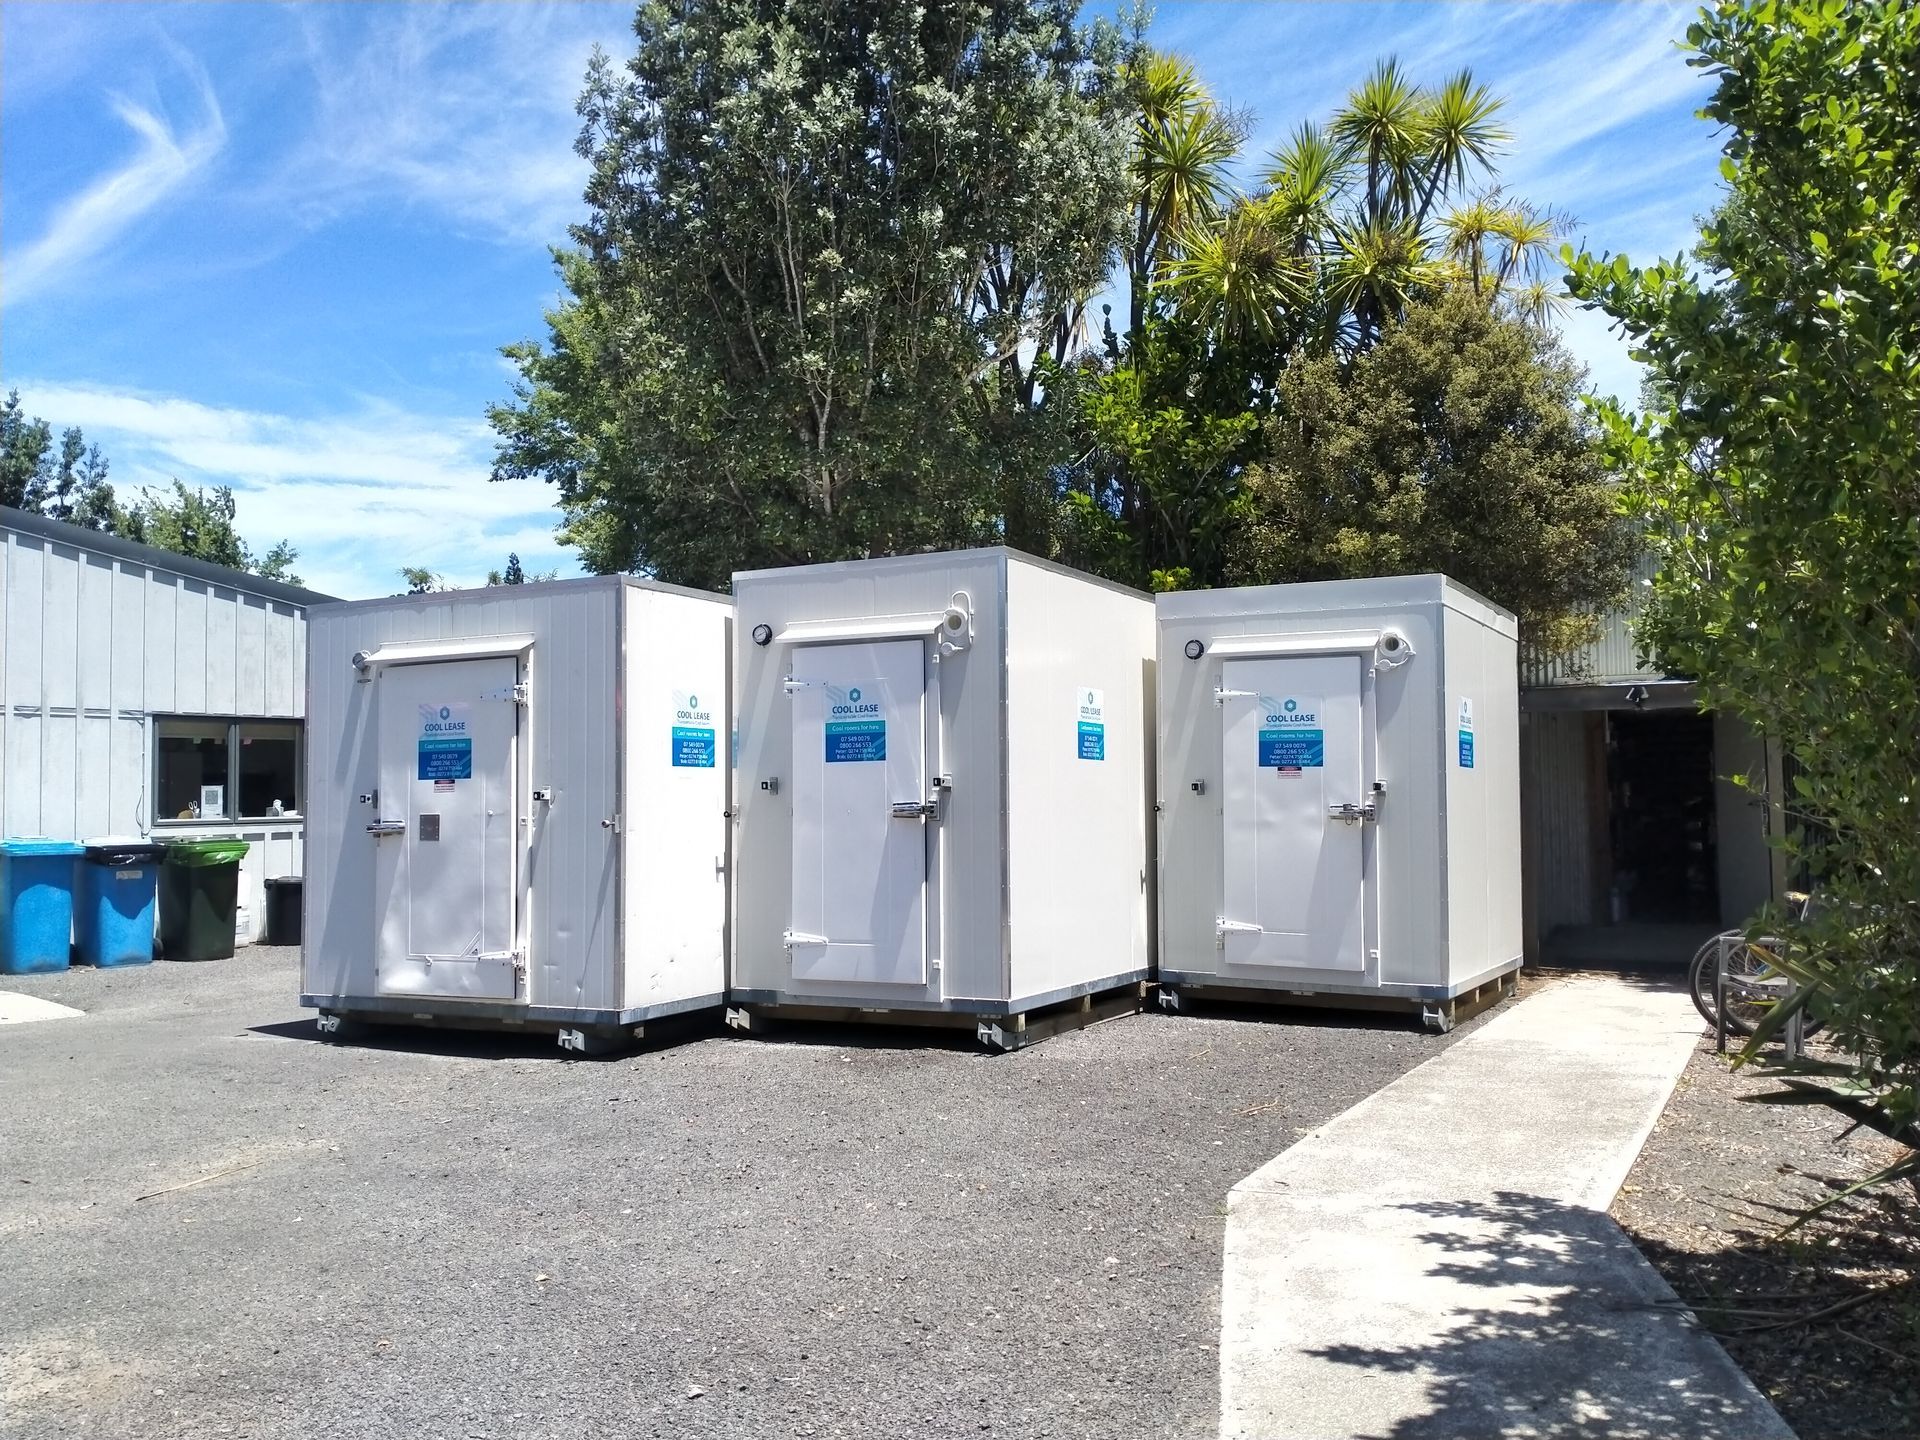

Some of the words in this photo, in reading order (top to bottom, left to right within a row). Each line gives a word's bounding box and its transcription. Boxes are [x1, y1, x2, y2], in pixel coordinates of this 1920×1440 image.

[832, 706, 853, 714] COOL
[854, 704, 878, 712] LEASE
[676, 710, 692, 719] COOL
[693, 712, 710, 720] LEASE
[445, 722, 465, 730] LEASE
